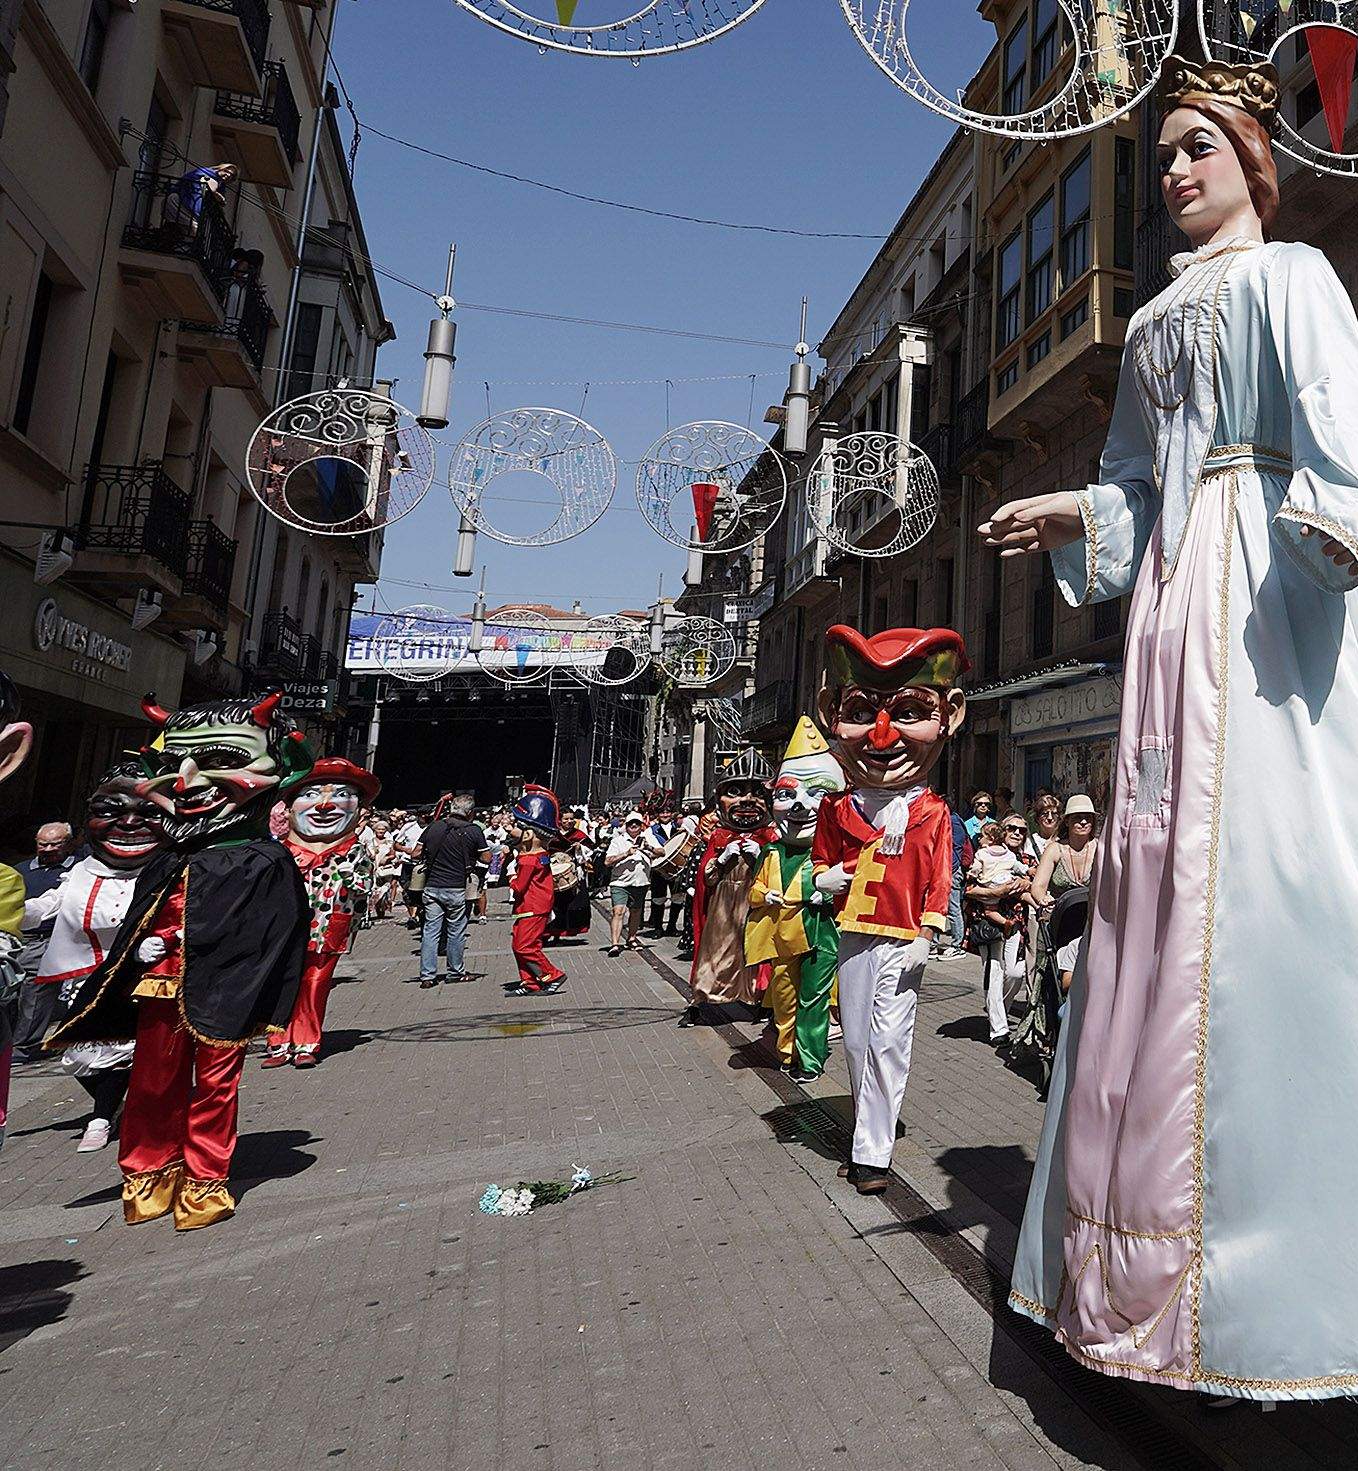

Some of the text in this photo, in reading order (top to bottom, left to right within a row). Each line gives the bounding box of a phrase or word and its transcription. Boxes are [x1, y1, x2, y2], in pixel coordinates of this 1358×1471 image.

[57, 616, 133, 672] YVES ROCHER
[283, 683, 329, 695] Viajes
[280, 696, 327, 708] Deza
[1035, 687, 1097, 723] SALOTTO
